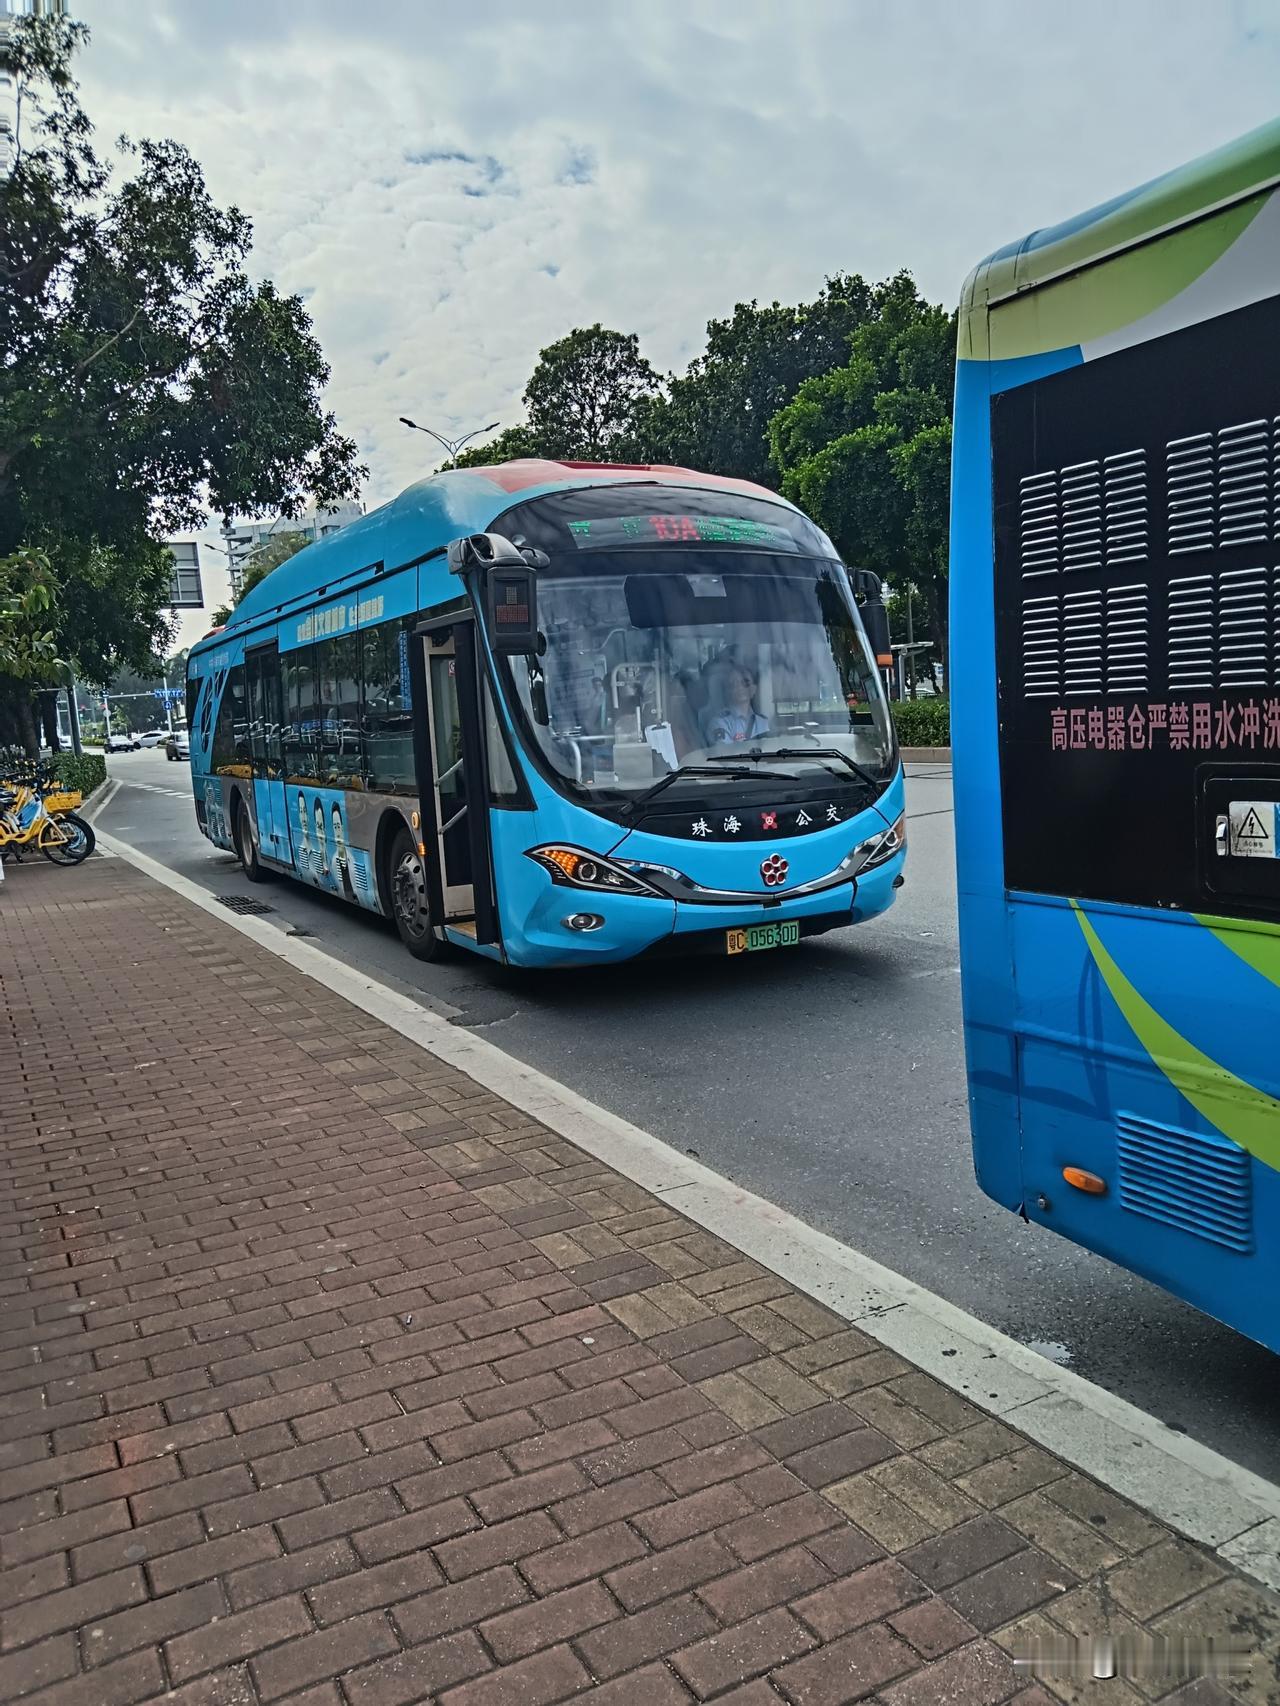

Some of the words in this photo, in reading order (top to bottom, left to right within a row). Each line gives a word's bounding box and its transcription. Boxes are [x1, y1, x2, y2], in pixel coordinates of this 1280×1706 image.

[1051, 699, 1280, 750] 高压电器仓严禁用水冲洗
